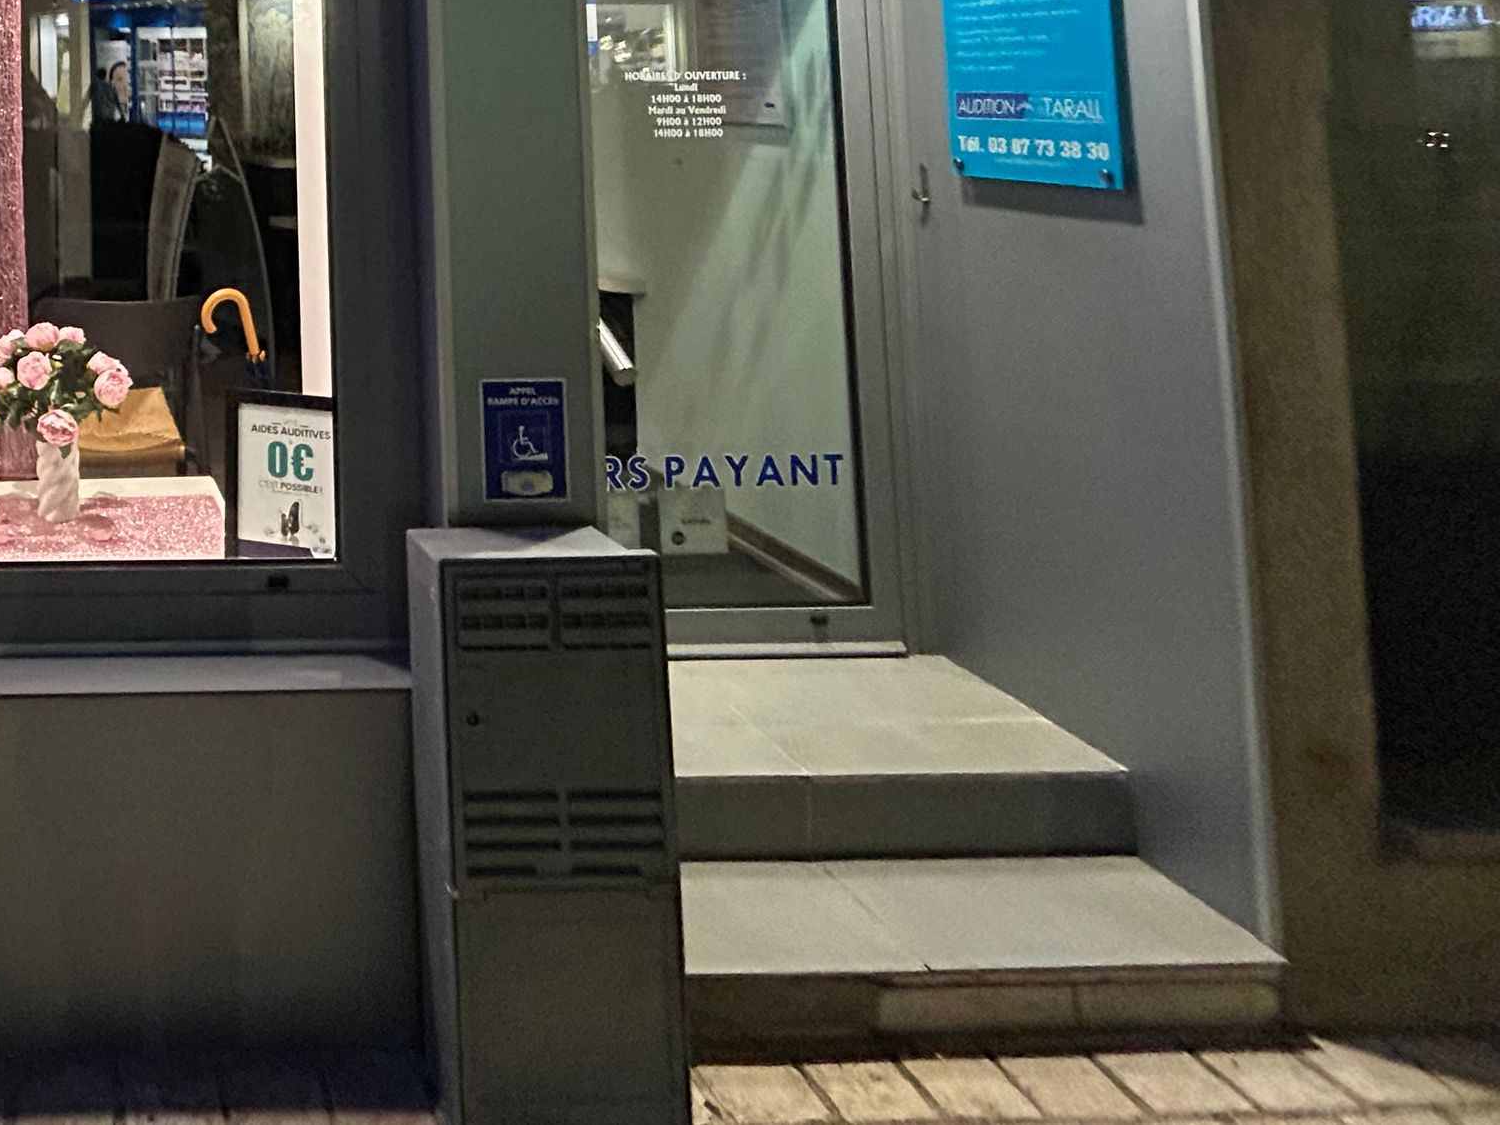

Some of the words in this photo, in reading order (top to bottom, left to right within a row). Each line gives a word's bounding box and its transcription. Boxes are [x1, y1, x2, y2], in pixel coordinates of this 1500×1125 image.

[684, 71, 741, 81] OUVERTURE
[674, 82, 699, 92] Lundi
[651, 94, 682, 103] 14H00
[691, 94, 723, 103] 18H00
[648, 105, 674, 115] Mardi
[675, 106, 686, 115] au
[687, 105, 727, 115] Vendredi
[957, 97, 1016, 116] AUDITION
[1041, 96, 1104, 121] TARALL
[656, 117, 682, 127] 9H00
[691, 117, 723, 126] 12H00
[654, 129, 683, 138] 14H00
[693, 128, 724, 138] 18H00
[957, 134, 986, 153] Tél.
[987, 135, 1008, 155] 03
[1033, 138, 1056, 158] 73
[1085, 141, 1111, 162] 30
[251, 423, 279, 435] AIDES
[280, 426, 331, 440] AUDITIVES
[267, 440, 314, 482] 0€
[662, 452, 845, 492] PAYANT
[279, 481, 319, 494] POSSIBLE
